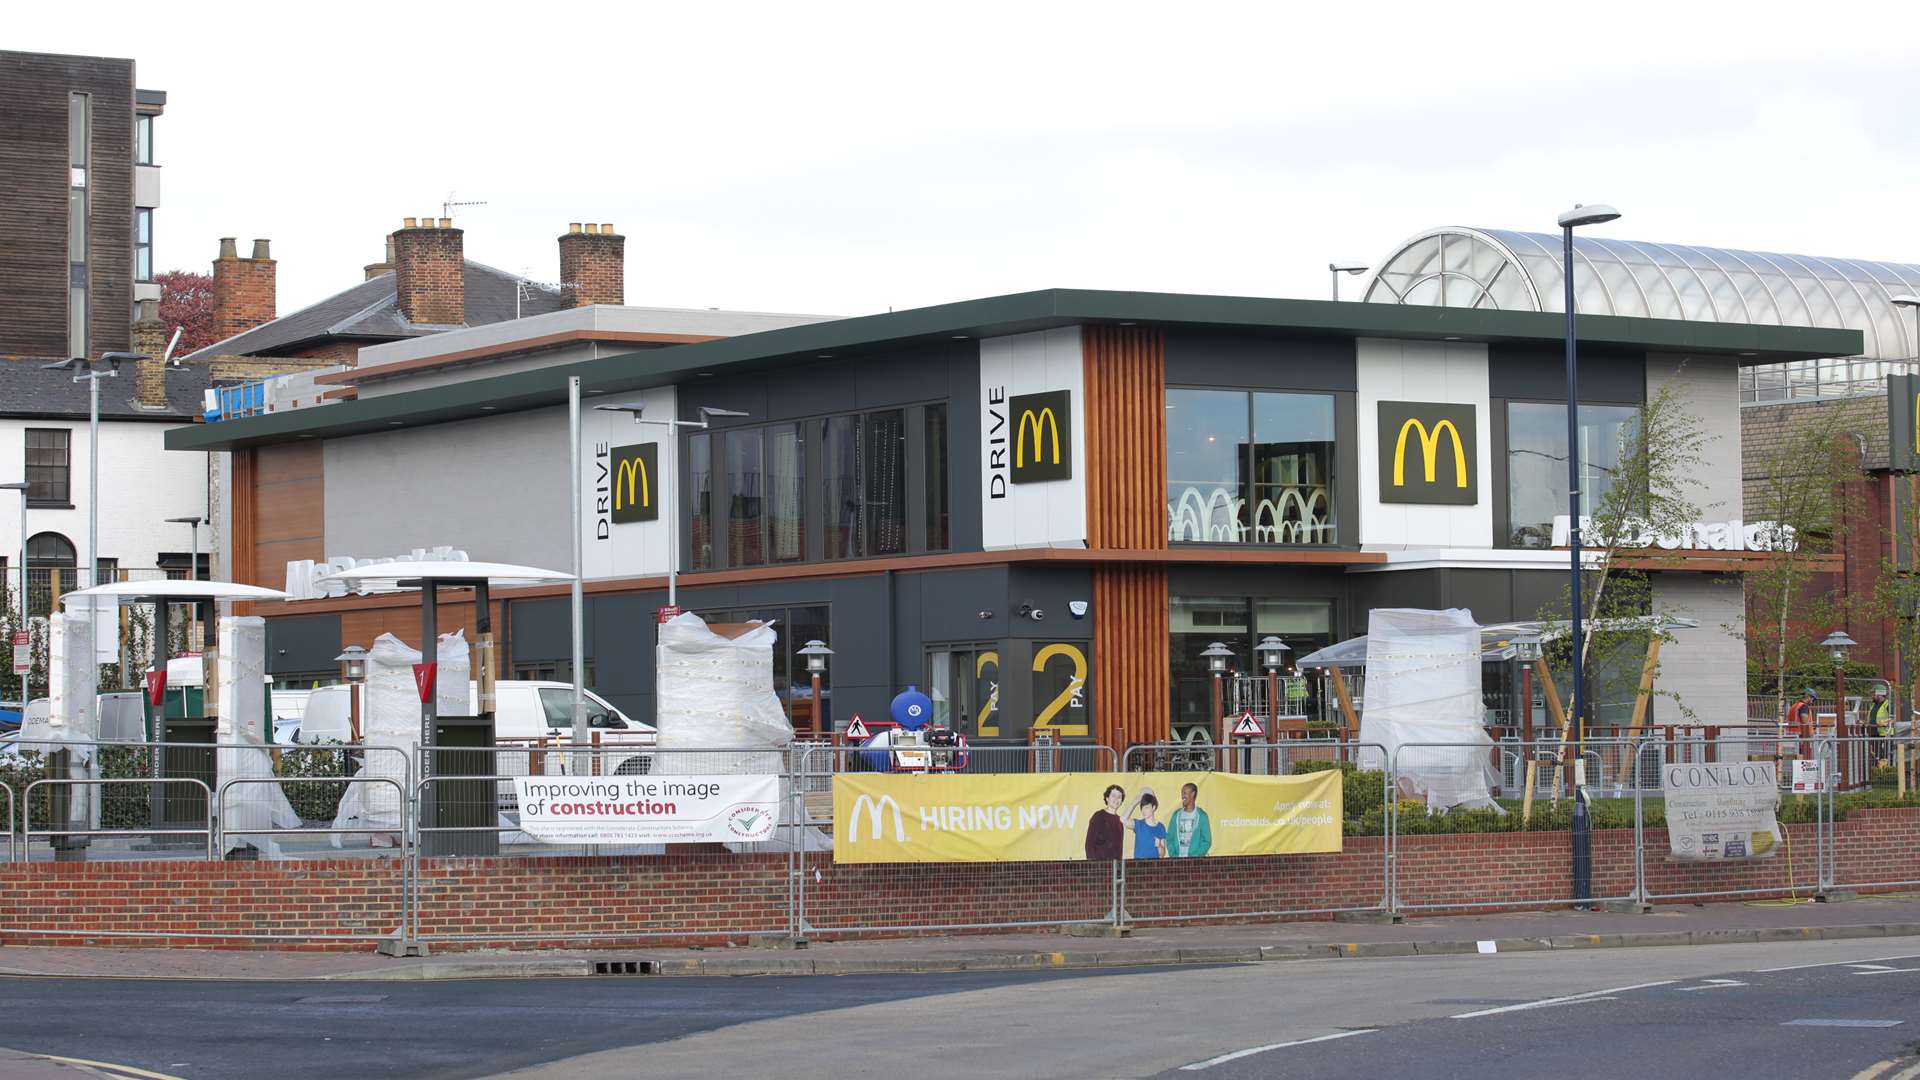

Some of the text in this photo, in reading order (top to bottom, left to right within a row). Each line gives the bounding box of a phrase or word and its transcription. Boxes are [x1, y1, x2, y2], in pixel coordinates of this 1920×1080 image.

[988, 385, 1006, 499] DRIVE
[596, 441, 609, 540] DRIVE
[990, 681, 998, 711] PAY
[1032, 643, 1089, 736] 2
[1070, 675, 1083, 708] PAY
[524, 780, 720, 801] Improving the image
[1670, 766, 1772, 788] CONLON
[526, 798, 677, 816] of construction
[728, 806, 773, 822] CONSIDERATE
[919, 804, 1079, 831] HIRING NOW
